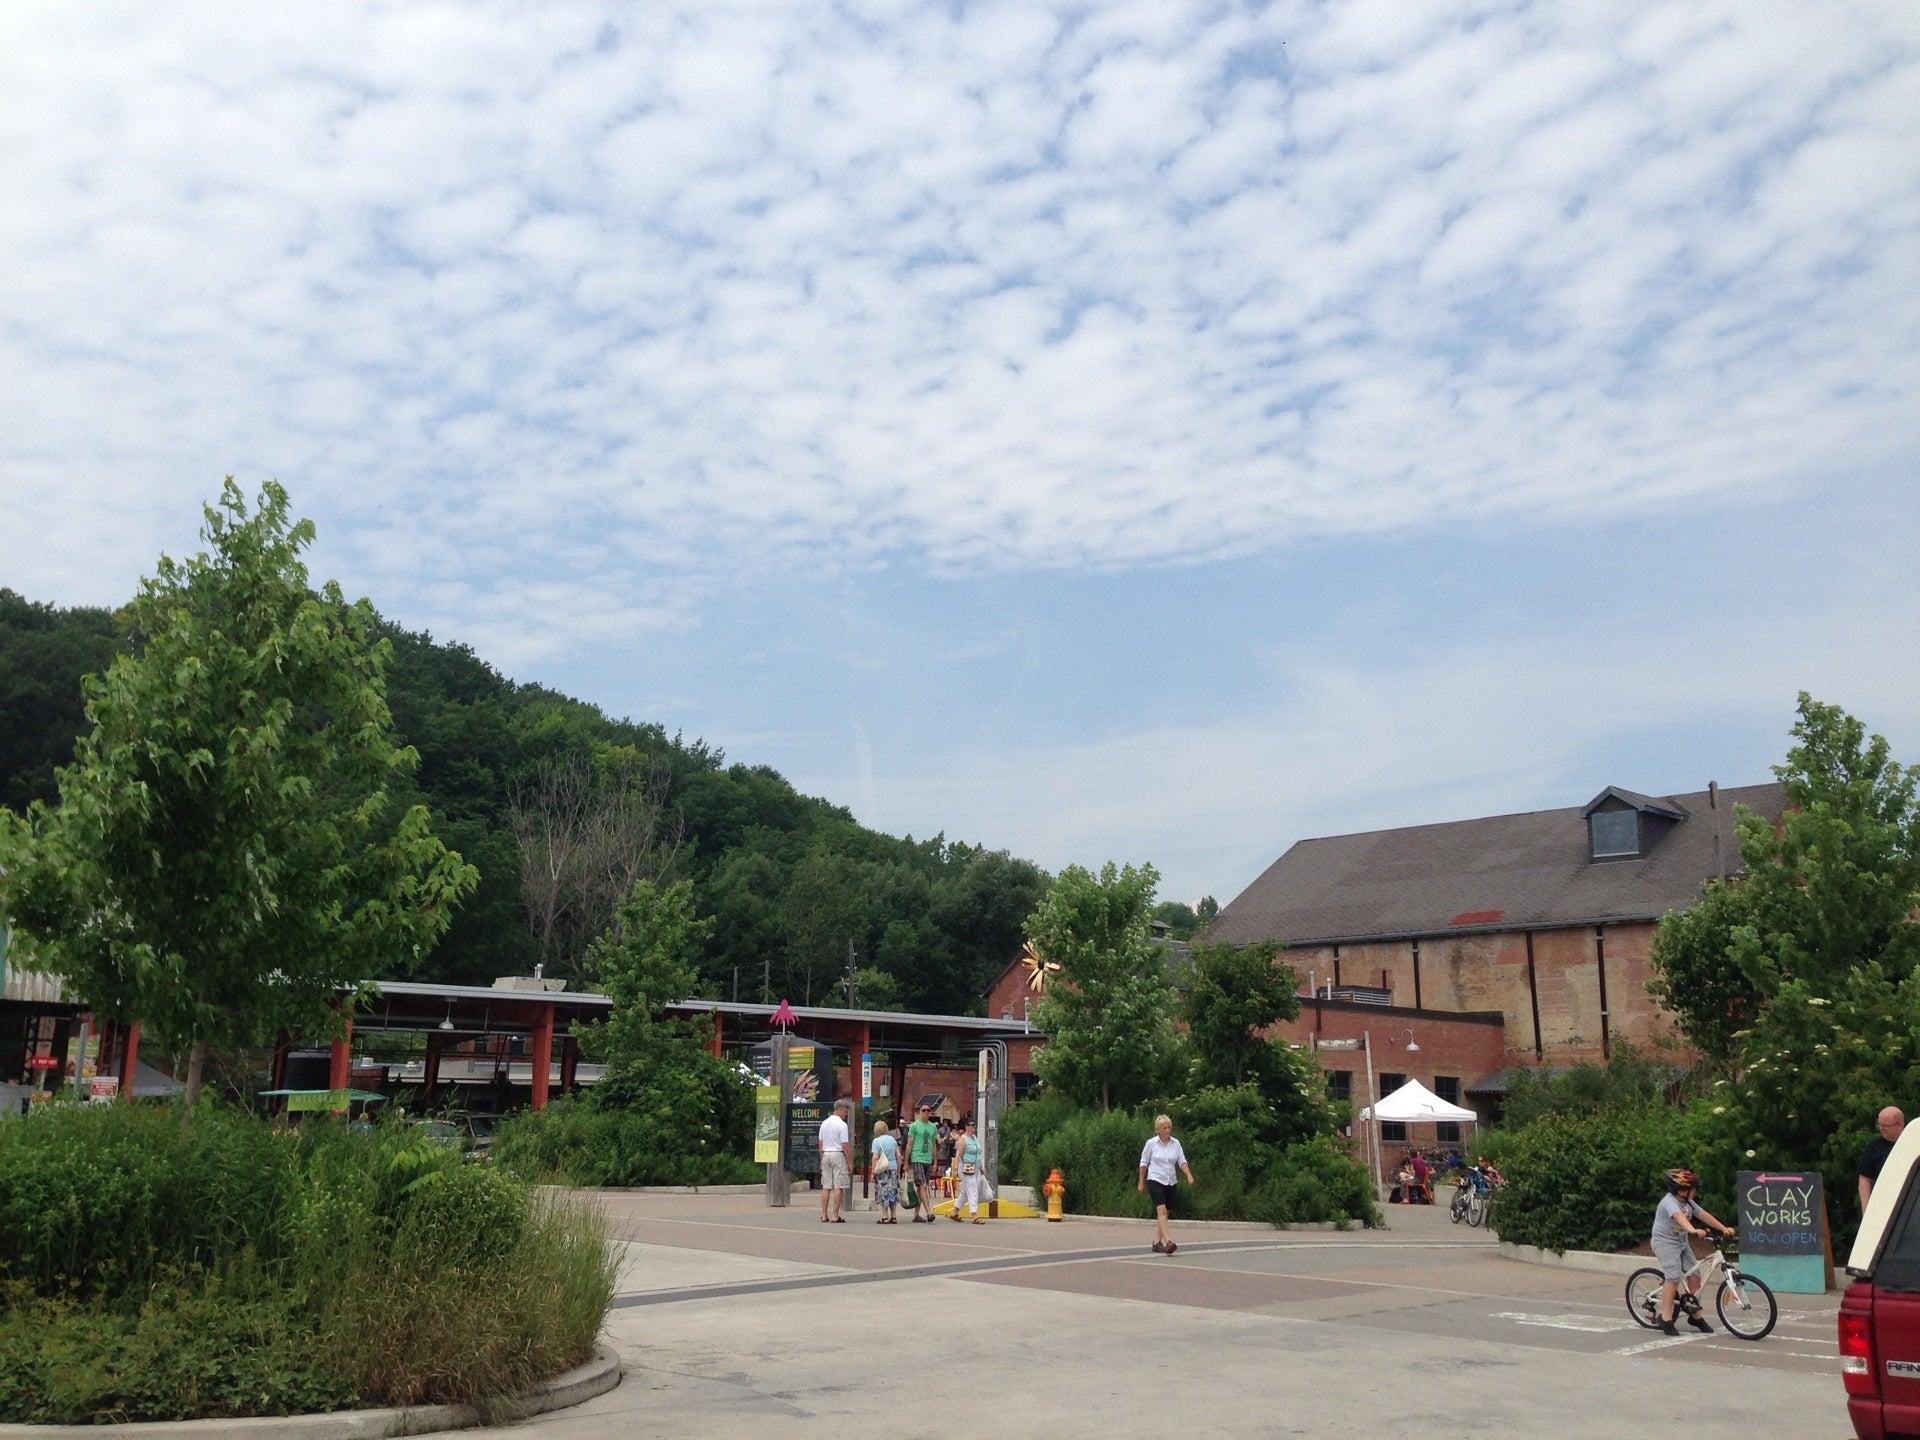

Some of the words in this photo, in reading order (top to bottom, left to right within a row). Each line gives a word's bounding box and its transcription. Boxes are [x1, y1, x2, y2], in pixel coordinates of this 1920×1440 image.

[792, 1108, 820, 1119] WELCOME
[1746, 1184, 1814, 1208] CLAY
[1745, 1209, 1812, 1226] WORKS
[1748, 1230, 1776, 1244] NOW
[1781, 1231, 1817, 1245] OPEN
